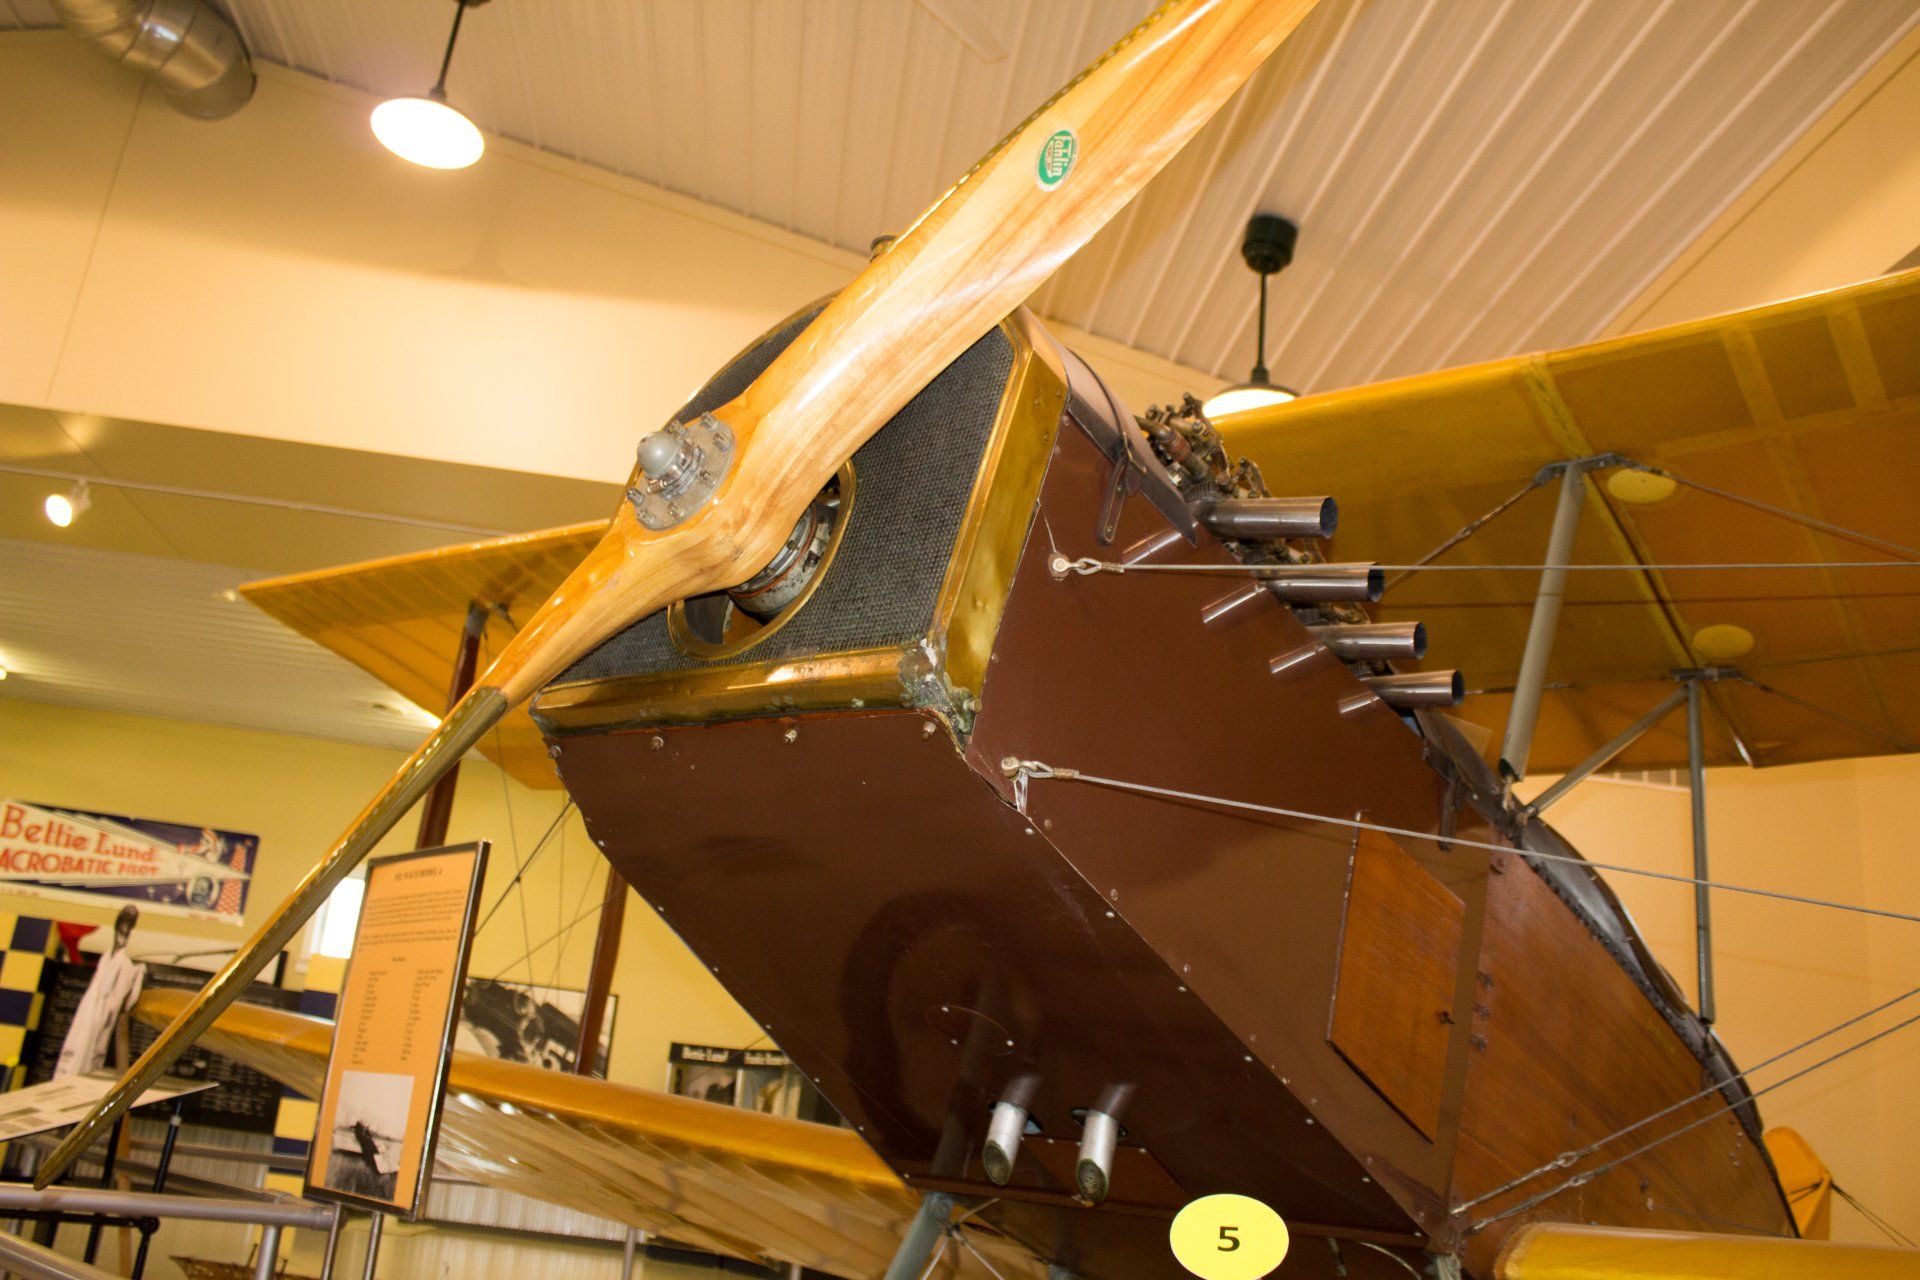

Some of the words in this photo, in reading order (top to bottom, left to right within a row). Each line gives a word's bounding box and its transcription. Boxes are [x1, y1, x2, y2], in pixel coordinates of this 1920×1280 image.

[1051, 134, 1073, 176] Fahlin
[0, 804, 89, 851] Bettie
[94, 832, 159, 862] Lund
[0, 849, 115, 876] ACROBATIC
[1217, 1226, 1241, 1252] 5
